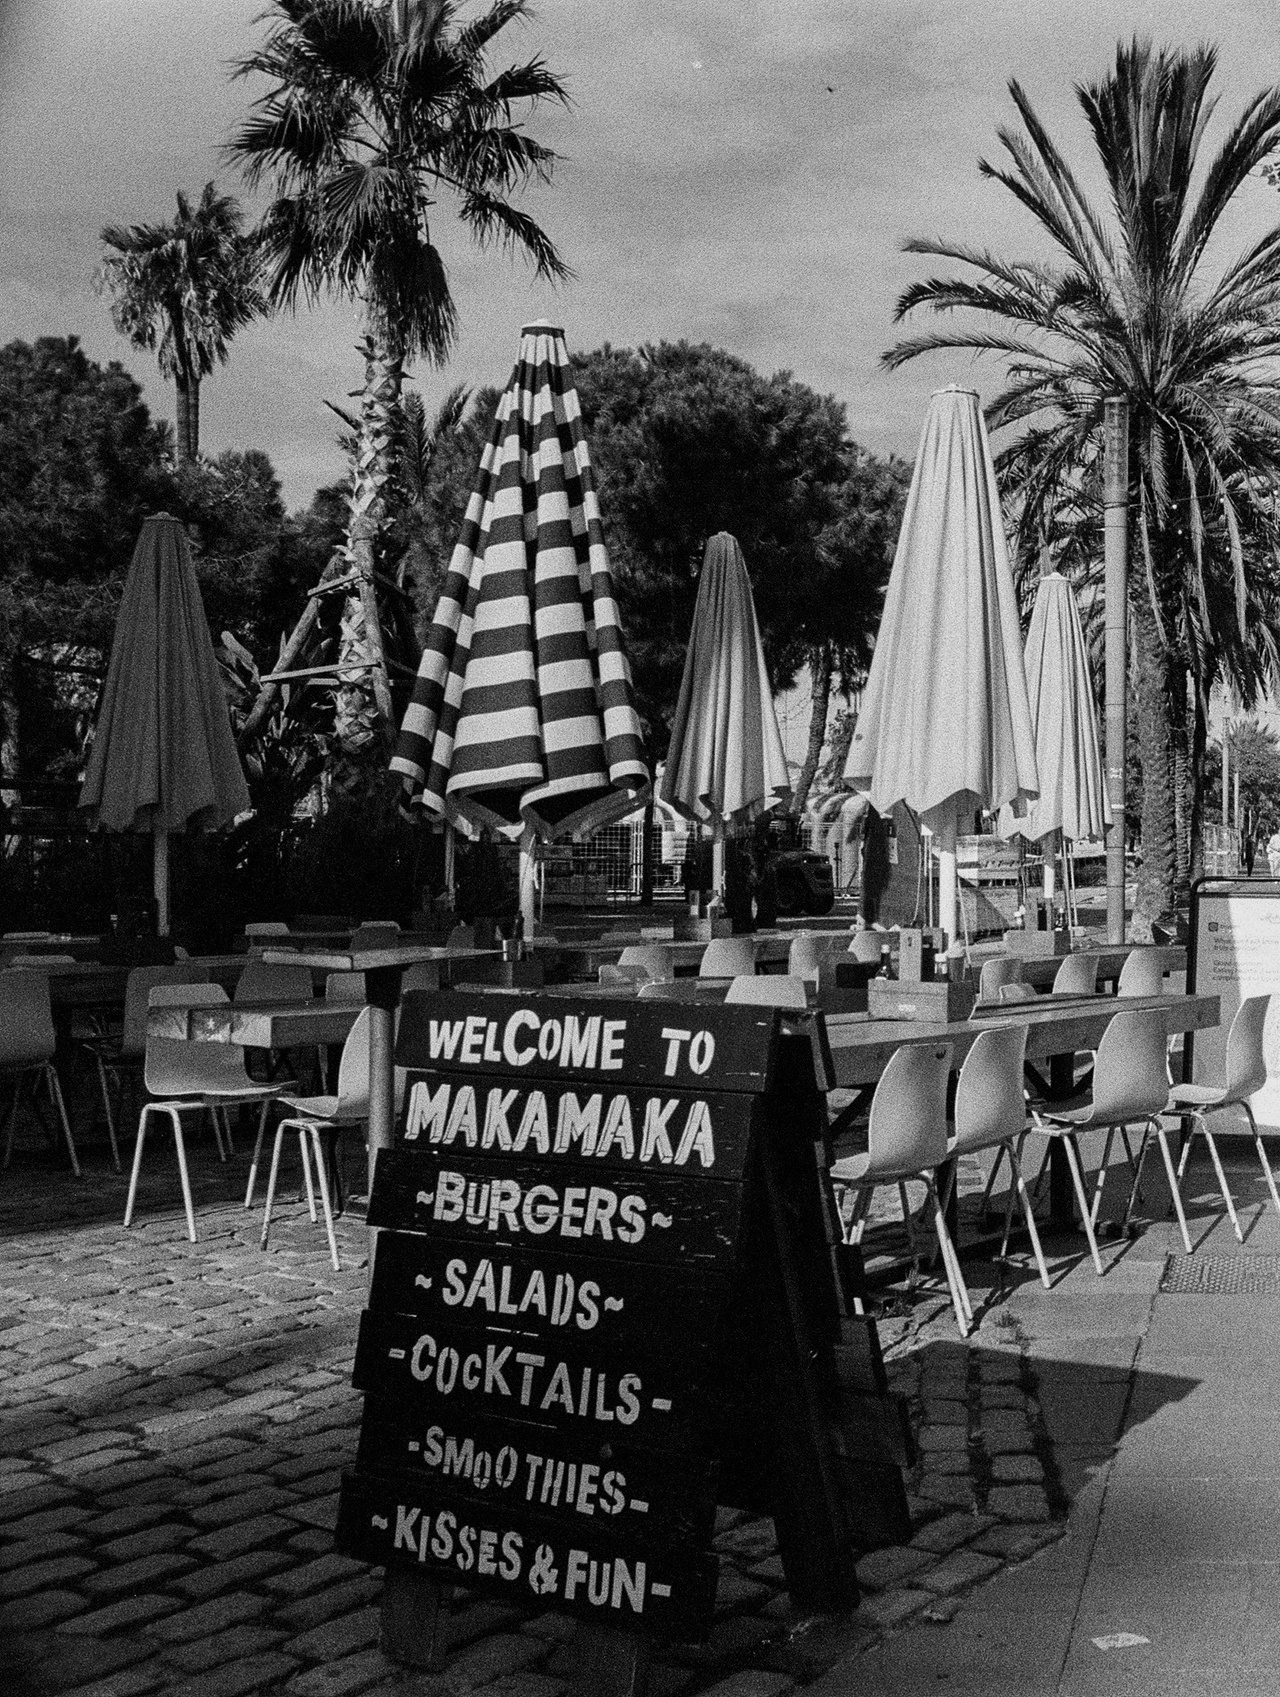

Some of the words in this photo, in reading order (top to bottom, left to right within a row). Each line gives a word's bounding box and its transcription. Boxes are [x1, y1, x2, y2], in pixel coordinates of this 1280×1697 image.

[429, 1009, 627, 1070] WELCOME
[661, 1026, 716, 1077] TO
[405, 1081, 715, 1168] MAKAMAKA
[529, 1546, 558, 1595] &
